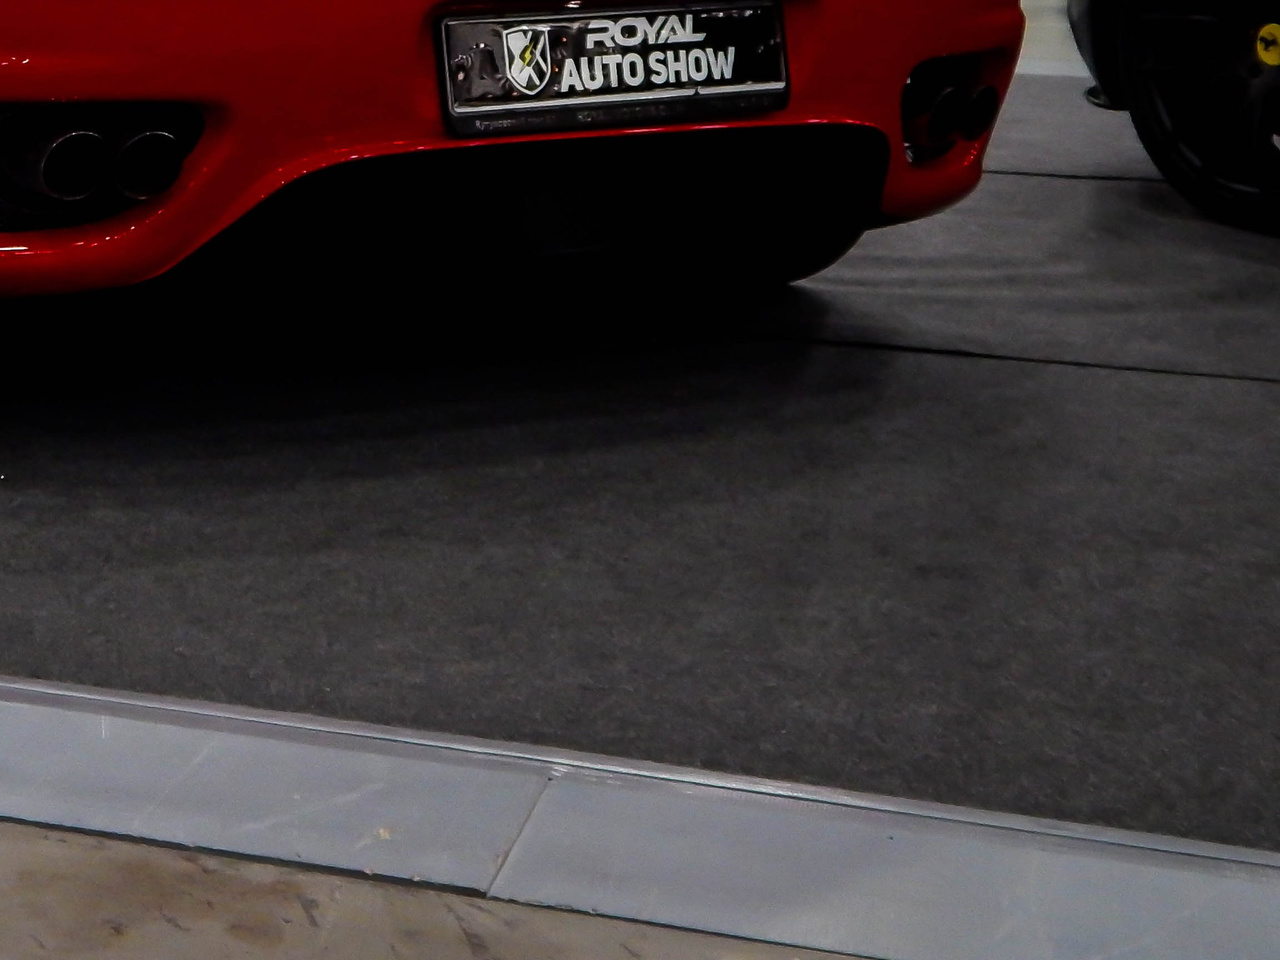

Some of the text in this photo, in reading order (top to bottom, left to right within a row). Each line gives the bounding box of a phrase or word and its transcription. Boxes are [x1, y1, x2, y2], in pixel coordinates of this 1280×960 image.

[586, 14, 708, 49] ROYAL
[560, 46, 737, 93] AUTO SHOW
